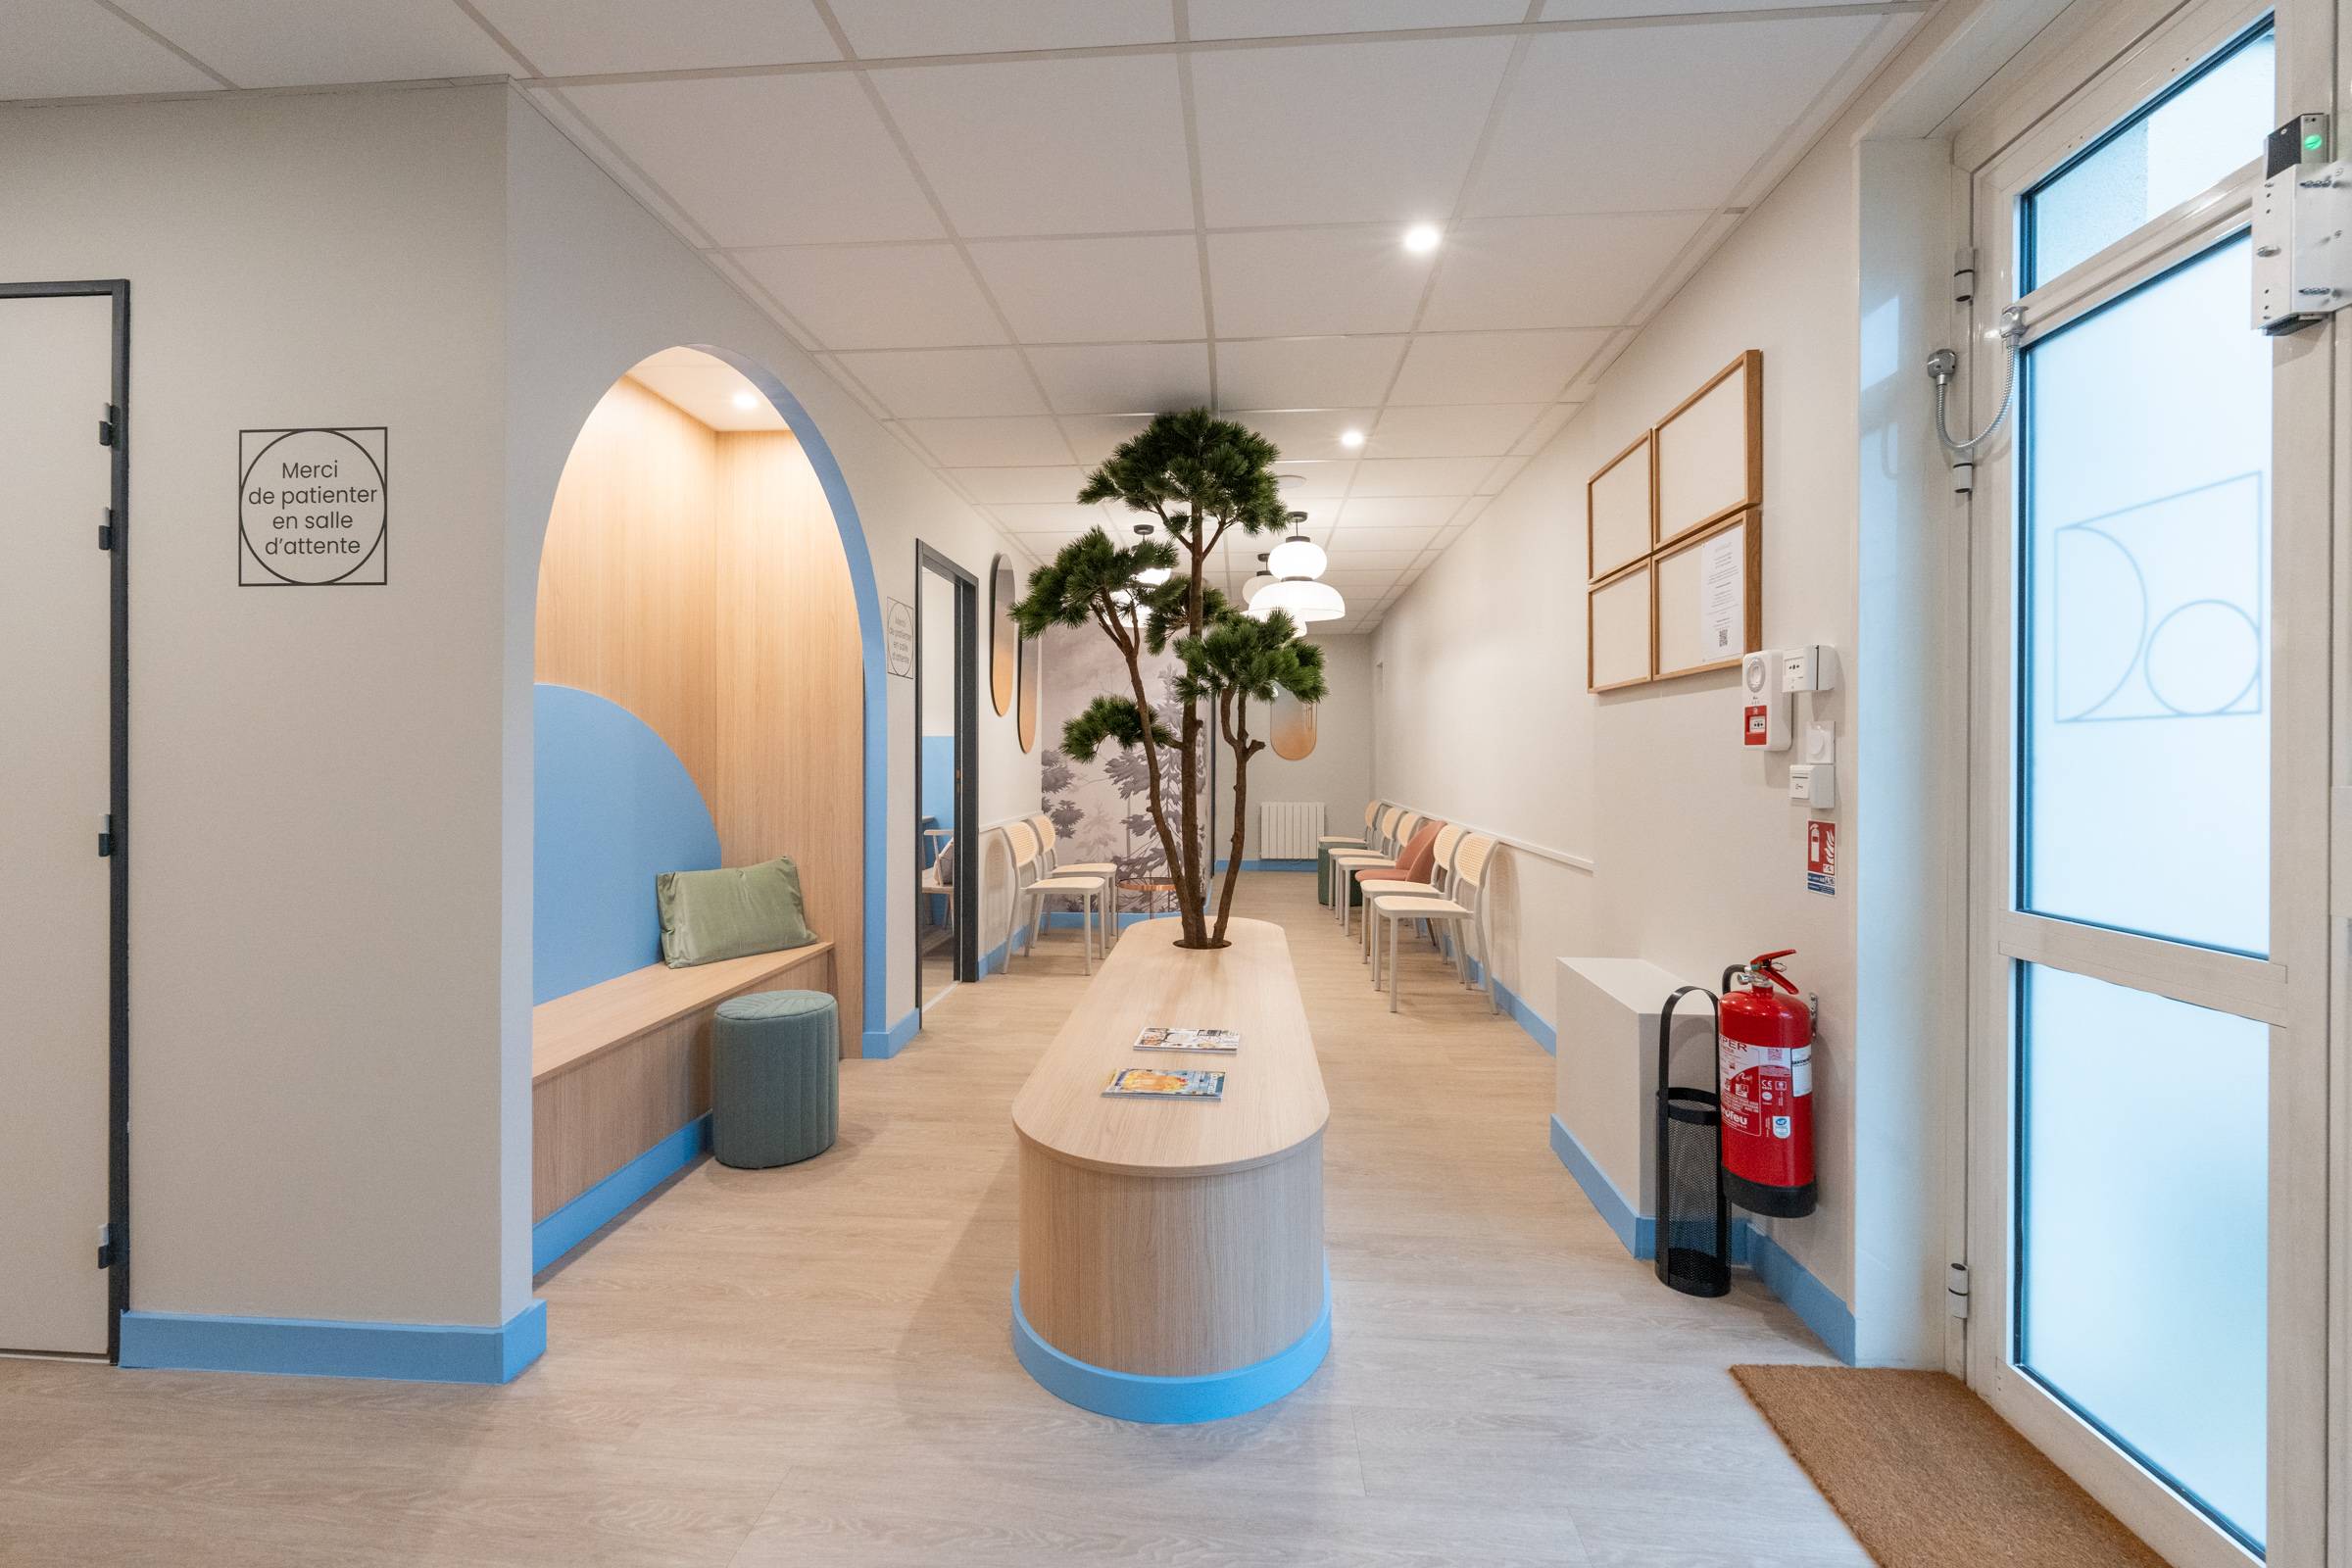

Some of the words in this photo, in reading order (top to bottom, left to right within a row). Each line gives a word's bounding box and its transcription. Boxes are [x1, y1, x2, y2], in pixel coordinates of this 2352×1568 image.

[282, 460, 338, 478] Merci
[249, 487, 275, 505] de
[282, 485, 377, 510] patienter
[272, 515, 298, 529] en
[305, 512, 353, 529] salle
[265, 537, 361, 555] d’attente
